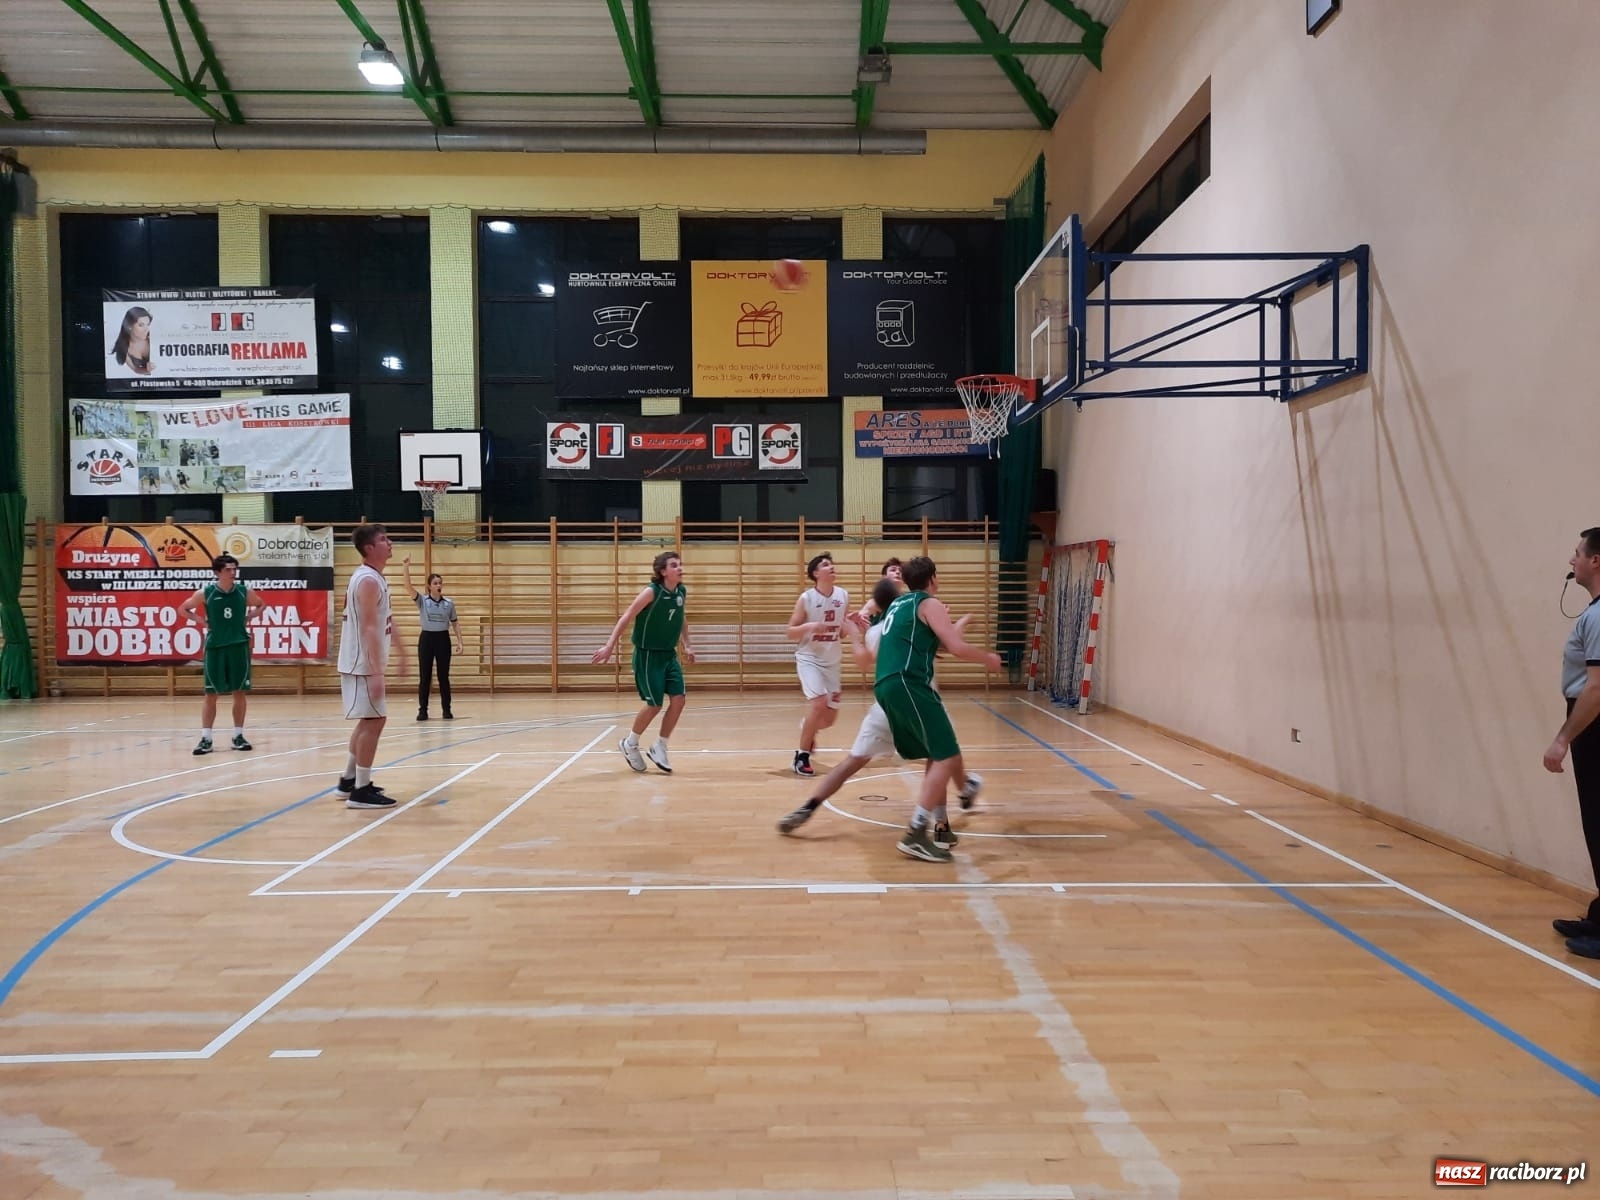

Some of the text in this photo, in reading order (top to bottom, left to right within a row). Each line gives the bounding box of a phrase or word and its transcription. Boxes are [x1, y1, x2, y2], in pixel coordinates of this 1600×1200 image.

[568, 272, 673, 280] DOKTORVOLT
[842, 271, 946, 279] DOKTORVOLT
[159, 341, 308, 361] FOTOGRAFIA REKLAMA
[610, 364, 629, 373] sklep
[630, 364, 674, 372] internetowy
[857, 362, 896, 370] Producent
[844, 372, 895, 381] budowlanych
[163, 412, 192, 426] WE
[253, 404, 291, 419] THIS
[298, 400, 342, 416] GAME
[866, 411, 922, 428] ARES
[262, 420, 281, 428] LIGA
[715, 426, 750, 456] PG
[76, 448, 136, 471] START
[257, 536, 329, 551] Dobrodzień
[72, 549, 141, 566] Drużynę
[67, 570, 83, 579] KS
[84, 569, 121, 579] START
[123, 569, 165, 579] MEBLE
[101, 582, 112, 591] w
[112, 580, 126, 590] III
[127, 580, 162, 590] LIDZE
[66, 593, 117, 606] wspiera
[66, 605, 178, 627] MIASTO
[223, 607, 233, 619] 8
[668, 608, 677, 621] 7
[882, 606, 900, 636] 6
[67, 621, 320, 657] DOBROIEŃ
